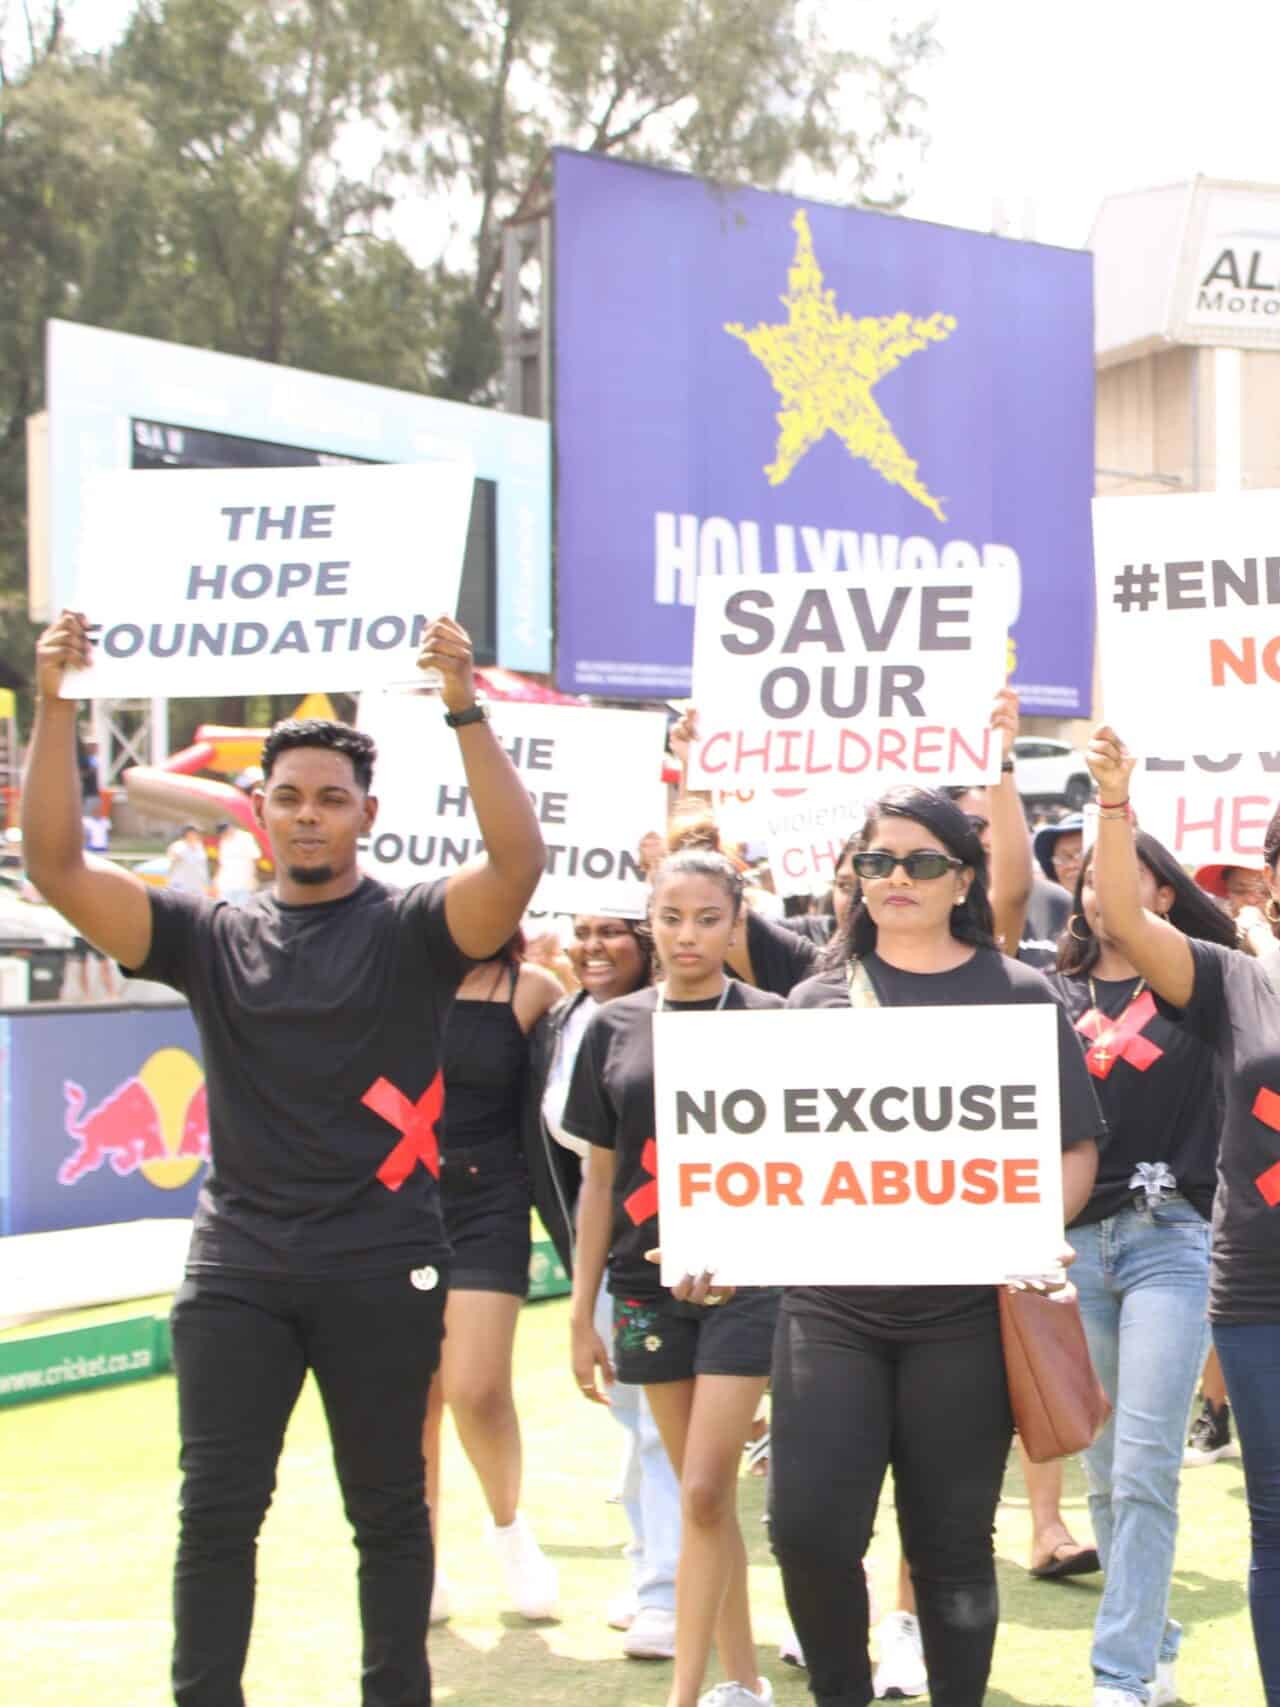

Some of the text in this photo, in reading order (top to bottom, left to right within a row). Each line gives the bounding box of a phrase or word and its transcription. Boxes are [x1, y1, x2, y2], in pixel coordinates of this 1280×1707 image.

[220, 504, 336, 542] THE
[185, 560, 351, 601] HOPE
[719, 584, 974, 656] SAVE
[759, 665, 927, 720] OUR
[498, 736, 555, 771] HE
[698, 726, 996, 775] CHILDREN
[436, 784, 569, 825] HE
[356, 832, 648, 882] OUNTION
[675, 1084, 1039, 1135] NO EXCUSE
[678, 1158, 1041, 1207] FOR ABUSE
